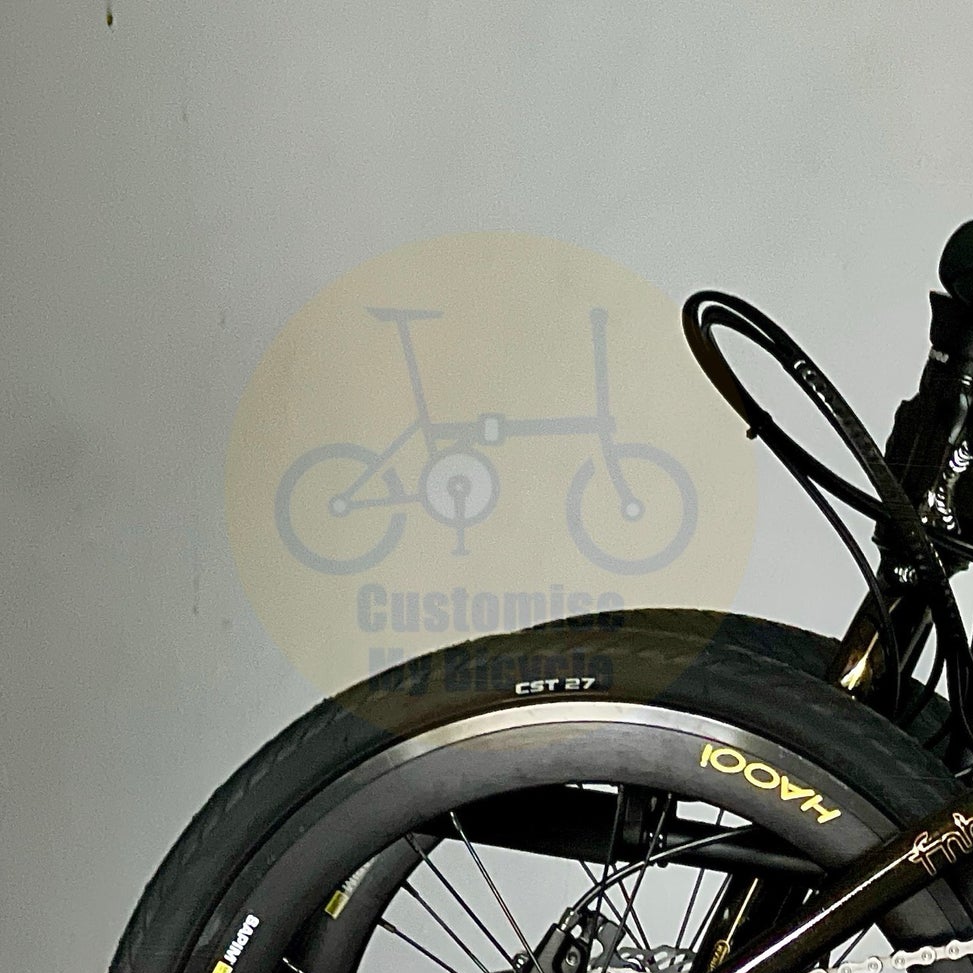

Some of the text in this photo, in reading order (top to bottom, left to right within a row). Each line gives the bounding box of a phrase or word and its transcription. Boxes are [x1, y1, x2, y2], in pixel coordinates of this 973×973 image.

[515, 677, 596, 695] CST 27
[223, 914, 260, 966] SAPIM
